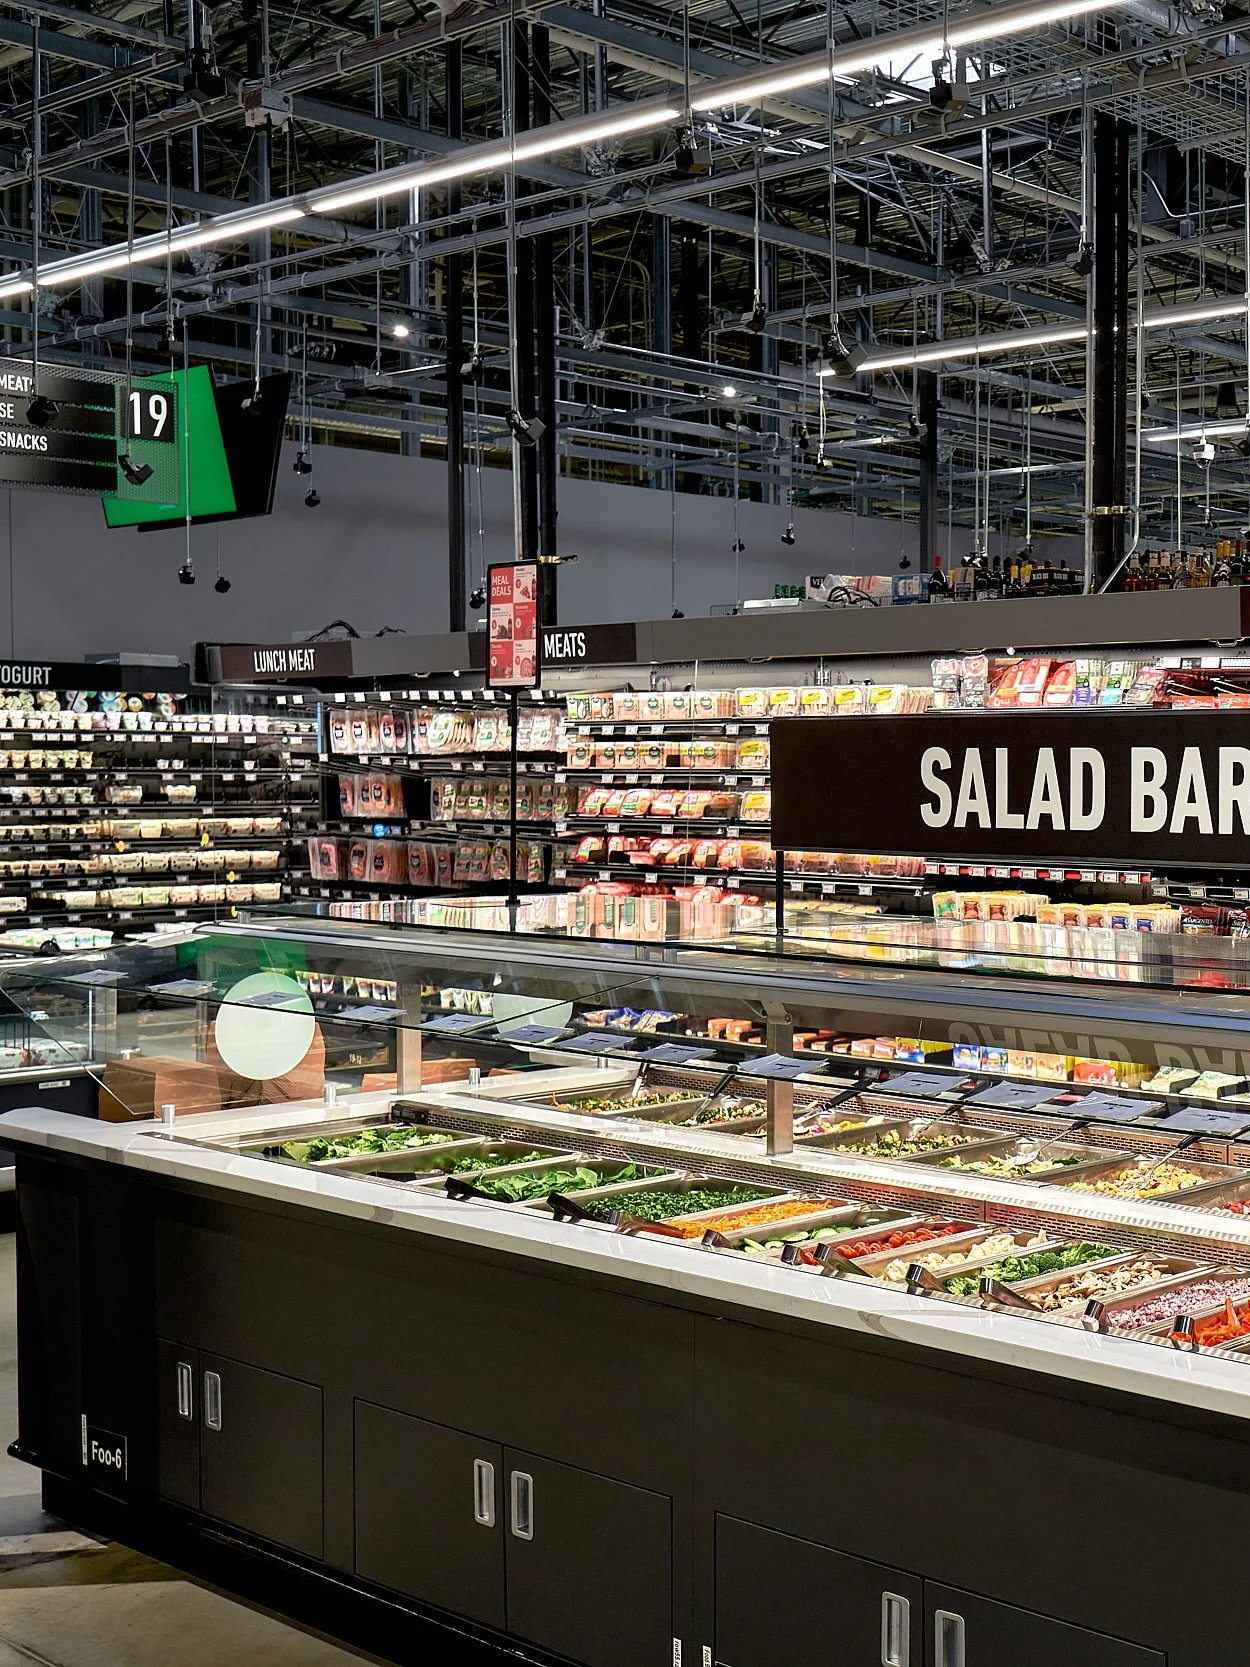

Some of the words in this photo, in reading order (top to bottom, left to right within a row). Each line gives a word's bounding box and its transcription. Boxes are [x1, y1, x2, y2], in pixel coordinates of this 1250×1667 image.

[129, 391, 167, 437] 19
[0, 431, 48, 452] SNACKS
[492, 576, 509, 586] MEAL
[492, 586, 512, 597] DEALS
[544, 632, 586, 659] MEATS
[253, 650, 287, 673] LUNCH
[288, 648, 315, 671] MEAT
[0, 665, 52, 685] OGURT
[920, 746, 1106, 831] SALAD
[92, 1440, 122, 1469] Foo-6
